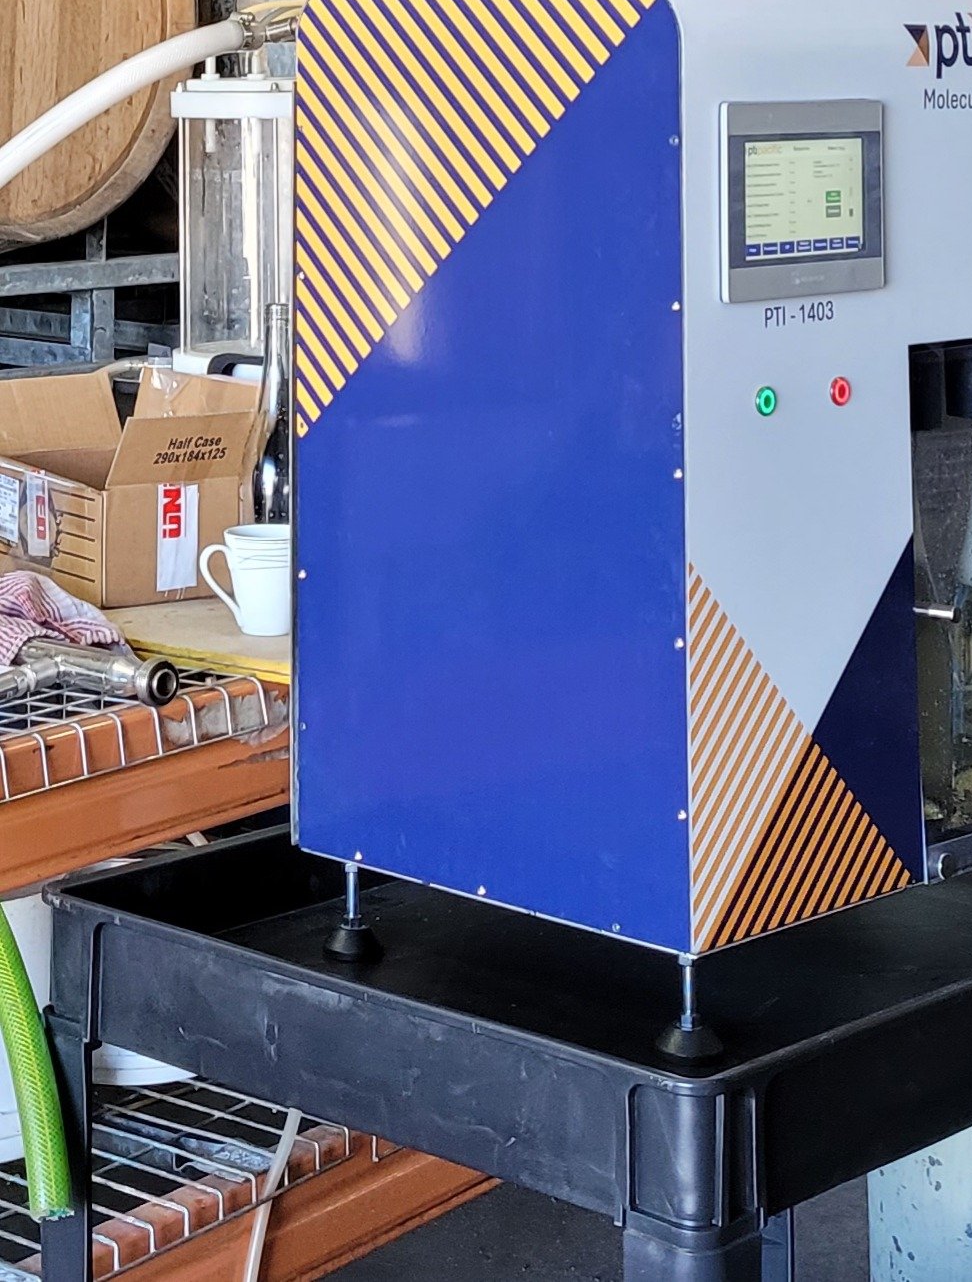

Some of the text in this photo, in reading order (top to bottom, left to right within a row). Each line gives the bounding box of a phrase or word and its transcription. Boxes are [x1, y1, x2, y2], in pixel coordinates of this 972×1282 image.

[764, 306, 786, 328] PTI
[799, 300, 834, 324] 1403
[168, 435, 222, 450] Half Case
[153, 447, 228, 464] 290x184x125
